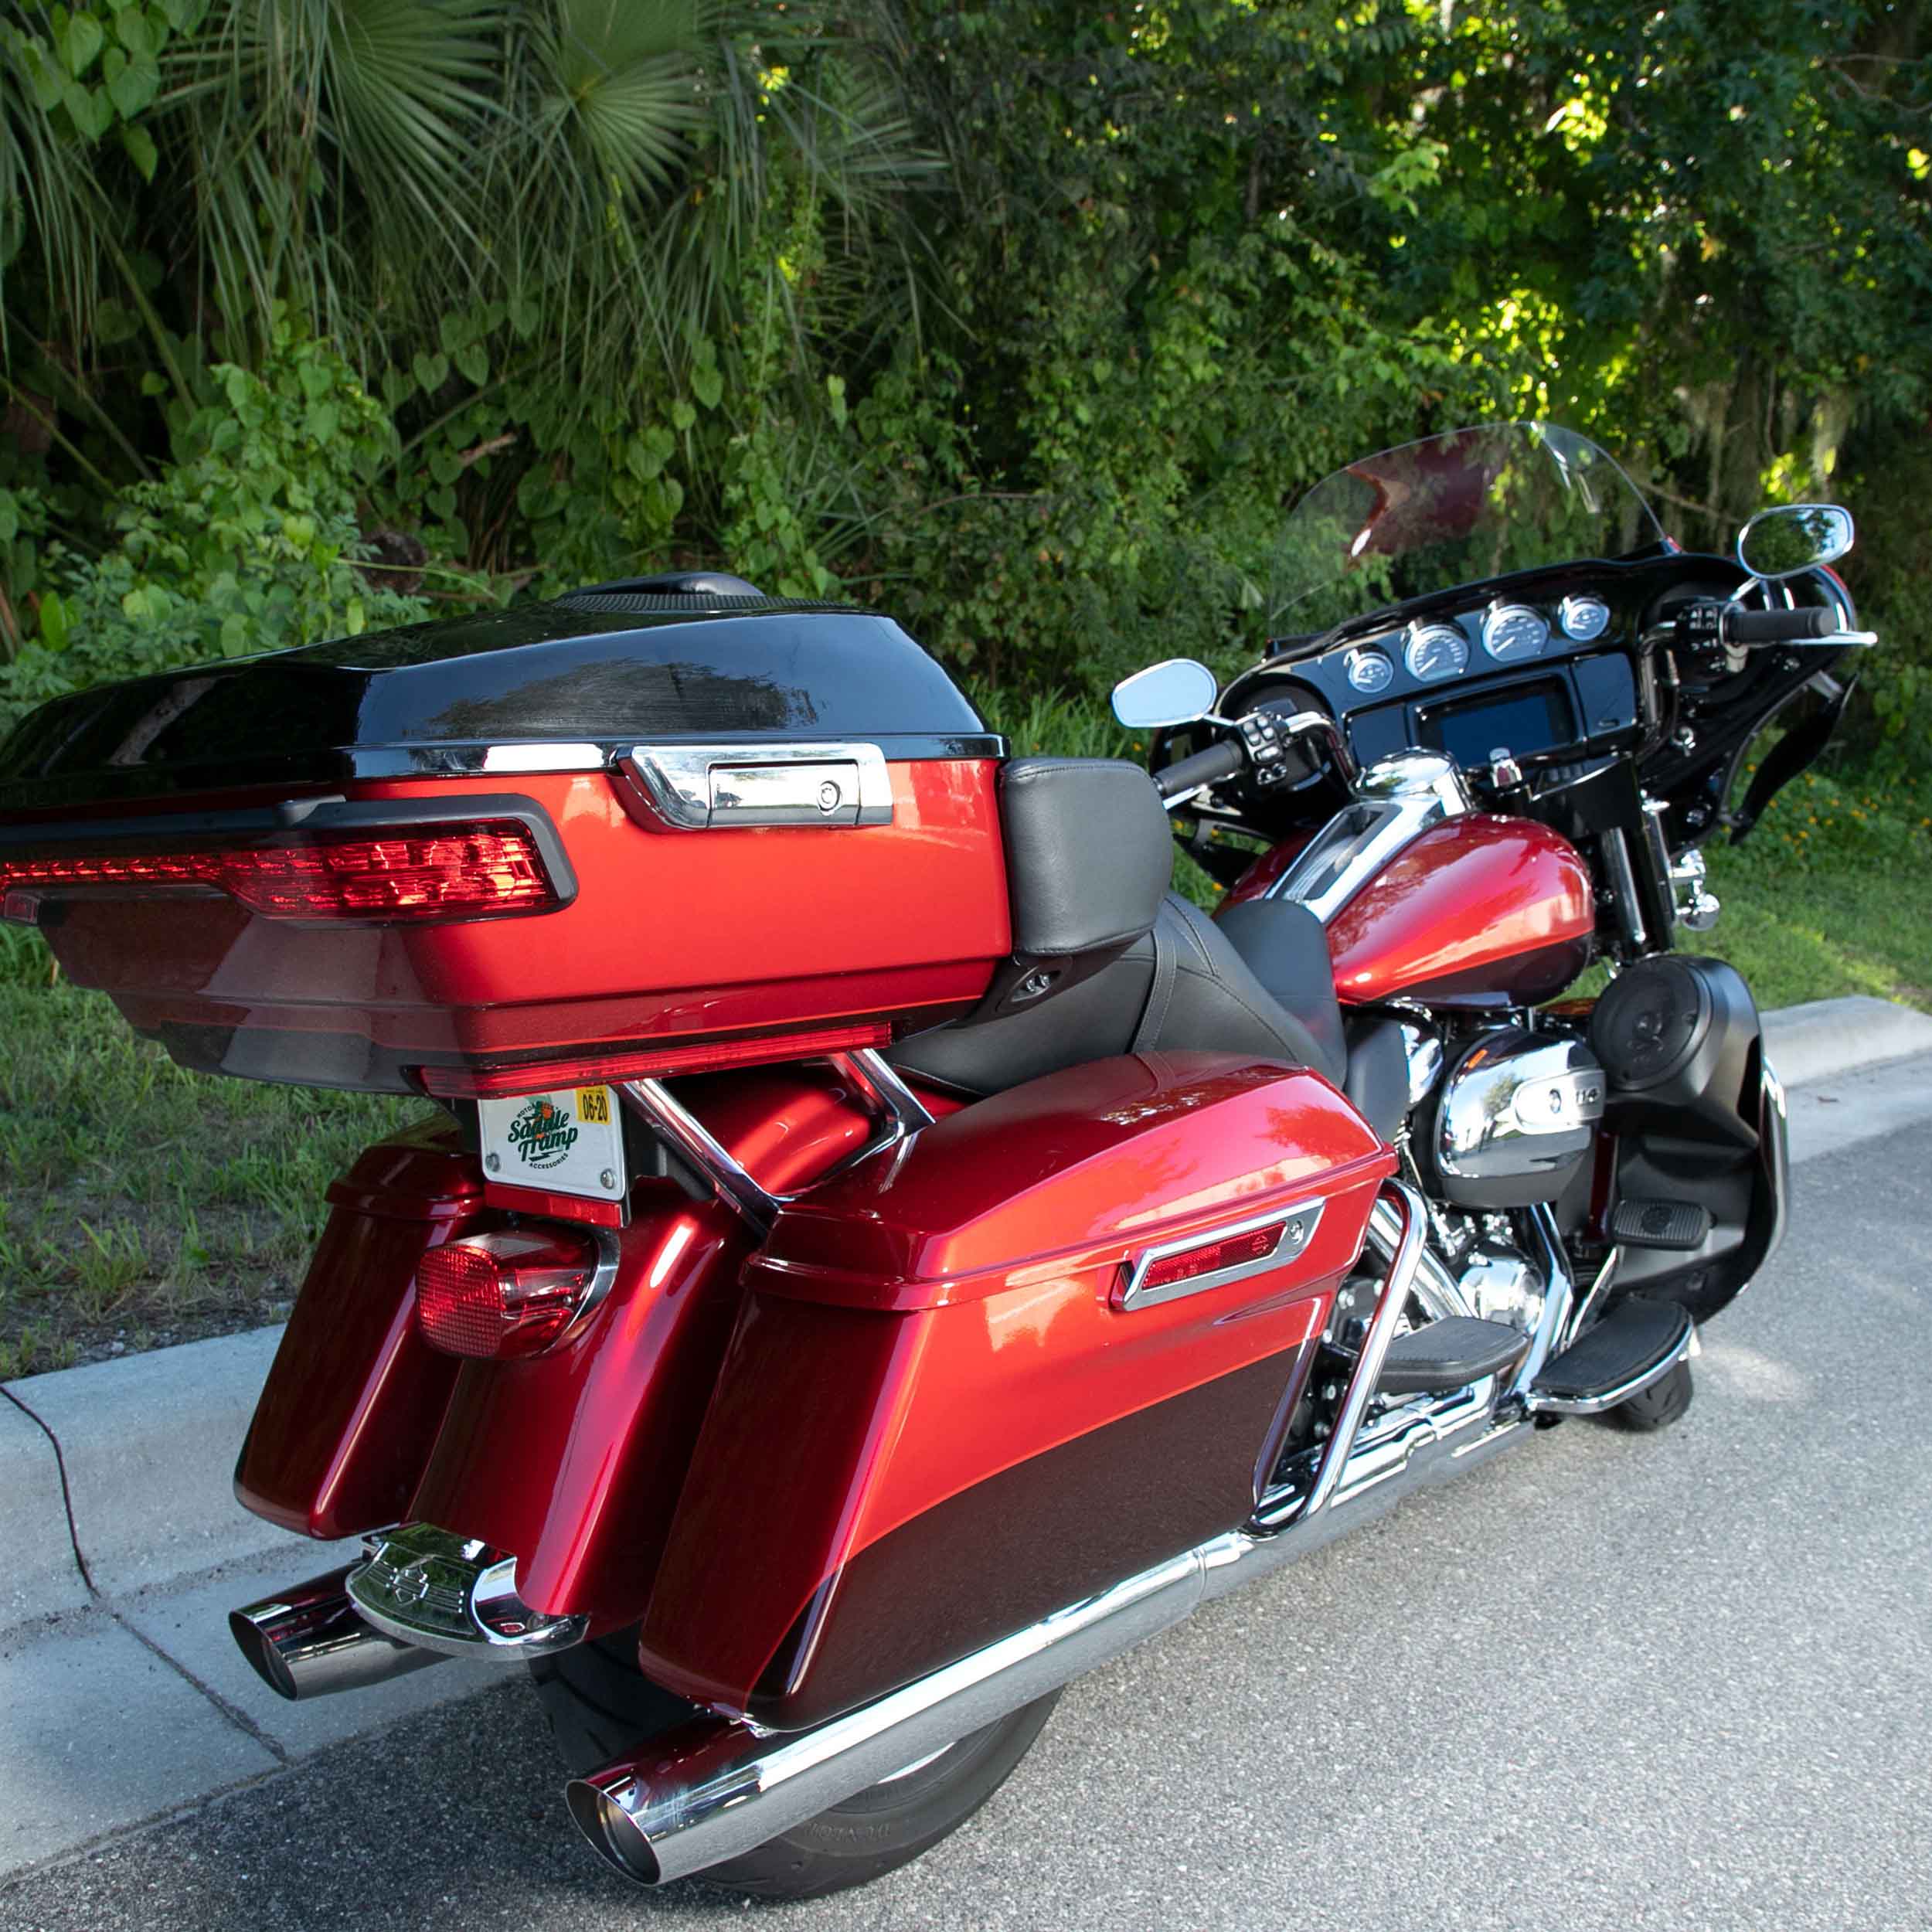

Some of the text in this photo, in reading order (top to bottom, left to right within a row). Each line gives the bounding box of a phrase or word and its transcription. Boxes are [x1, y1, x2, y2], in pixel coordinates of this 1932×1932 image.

[583, 1094, 607, 1121] 06-20
[518, 1127, 578, 1162] Tramp
[529, 1152, 569, 1169] ACCESSORIES
